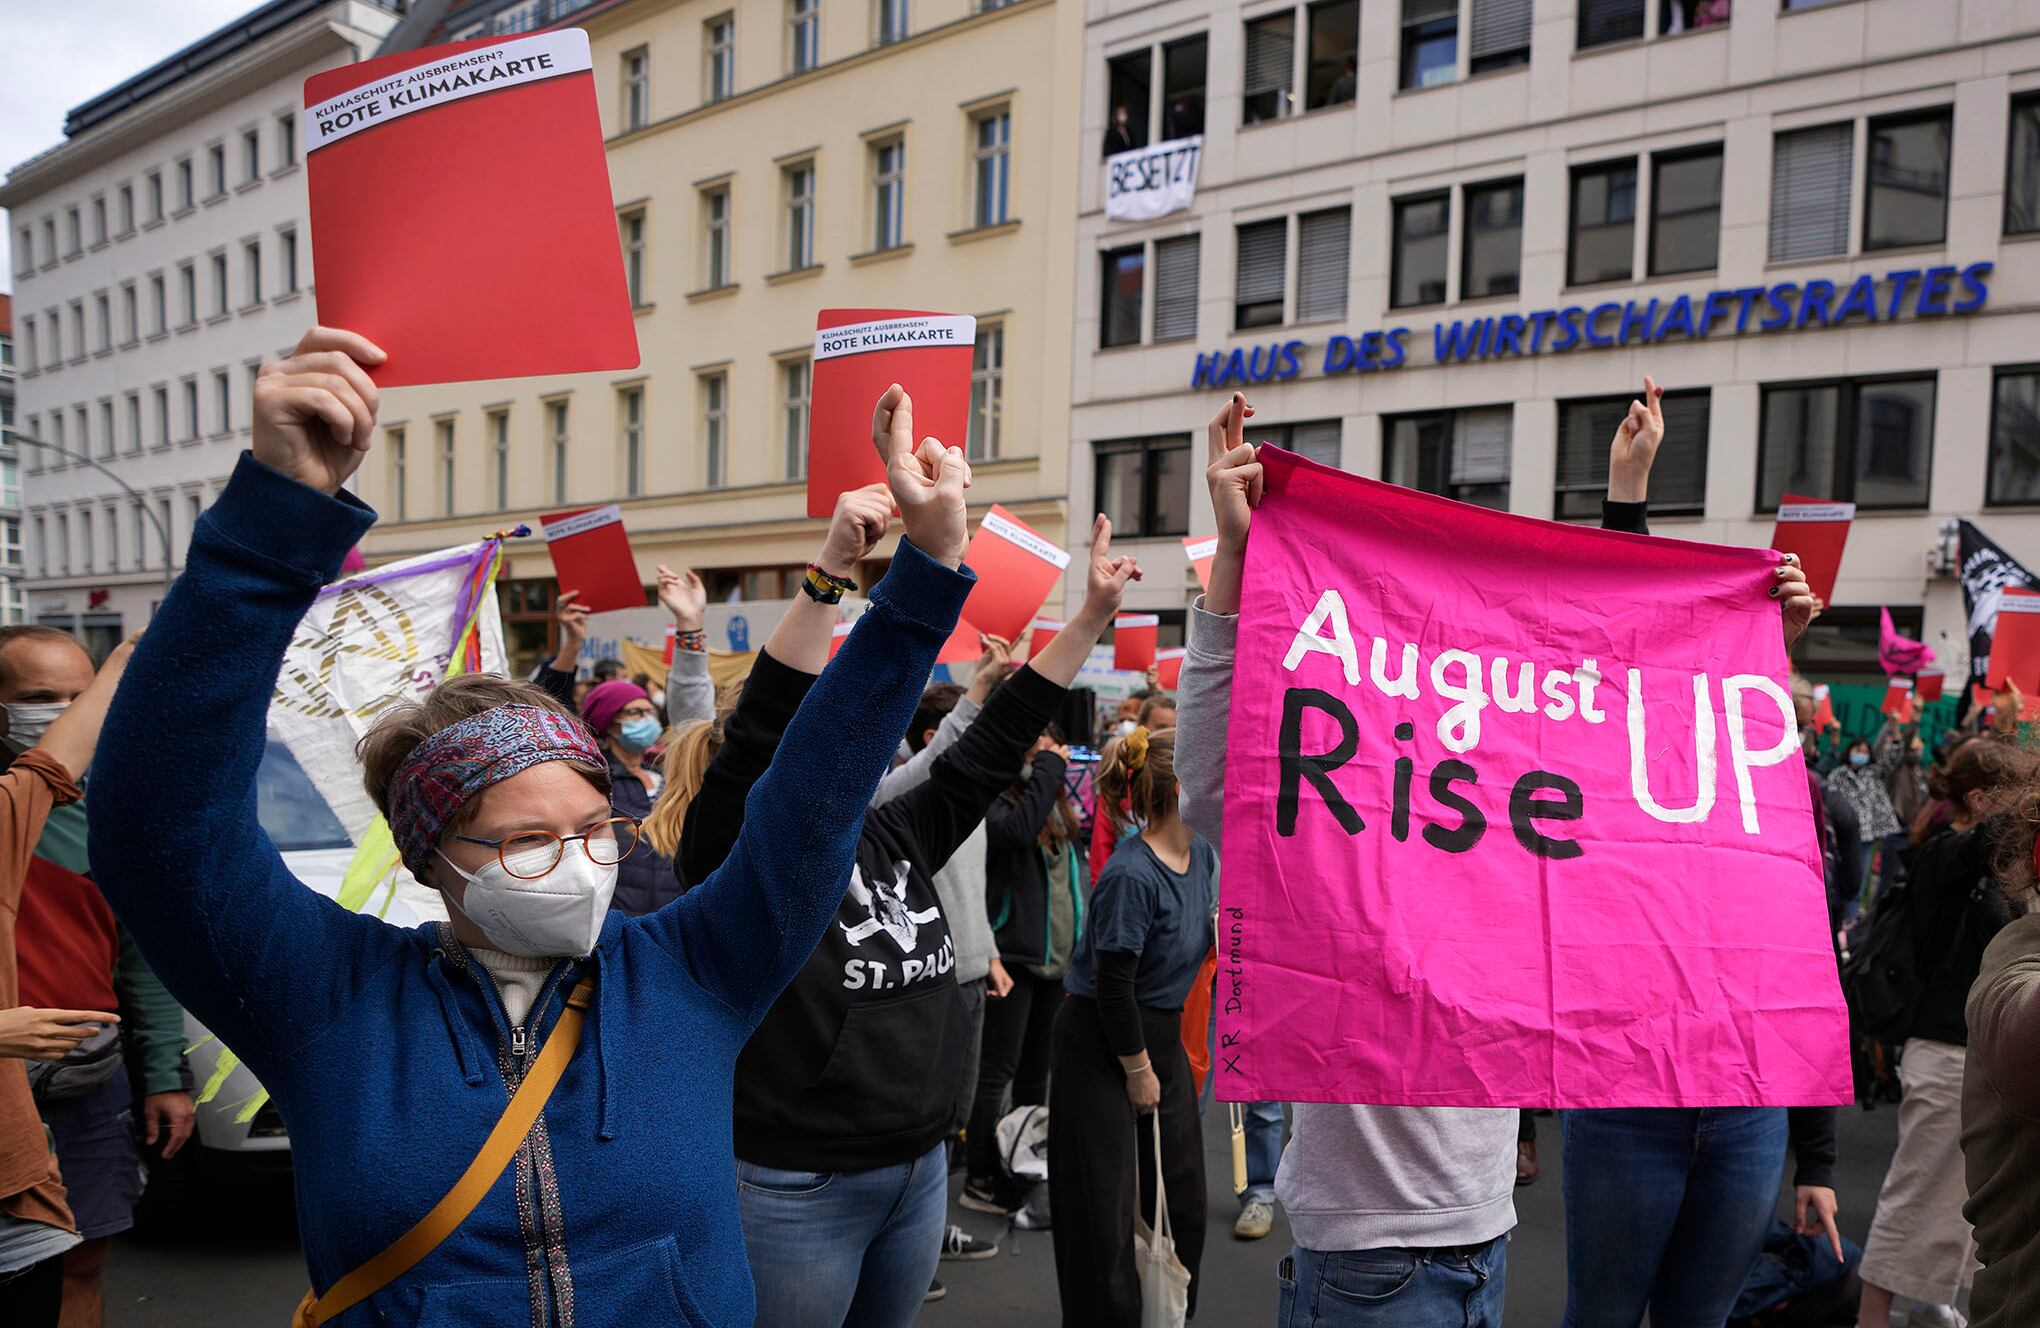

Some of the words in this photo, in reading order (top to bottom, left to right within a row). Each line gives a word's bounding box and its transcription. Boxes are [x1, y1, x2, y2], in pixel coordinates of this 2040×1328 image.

[316, 79, 404, 119] KLIMASCHUTZ
[408, 50, 504, 84] AUSBREMSEN?
[319, 100, 382, 137] ROTE
[389, 53, 554, 109] KLIMAKARTE
[1108, 145, 1200, 199] BESETZT
[822, 326, 872, 340] KLIMASCHUTZ
[874, 321, 929, 332] AUSBREMSEN?
[823, 337, 858, 353] ROTE
[862, 329, 954, 346] KLIMAKARTE
[1191, 340, 1305, 391] HAUS
[1322, 327, 1409, 374] DES
[1434, 262, 1995, 363] WIRTSCHAFTSRATES
[1281, 589, 1606, 754] August
[1276, 687, 1585, 860] Rise
[1626, 667, 1801, 835] UP
[842, 958, 895, 990] ST.
[1224, 908, 1244, 1016] Dortmund
